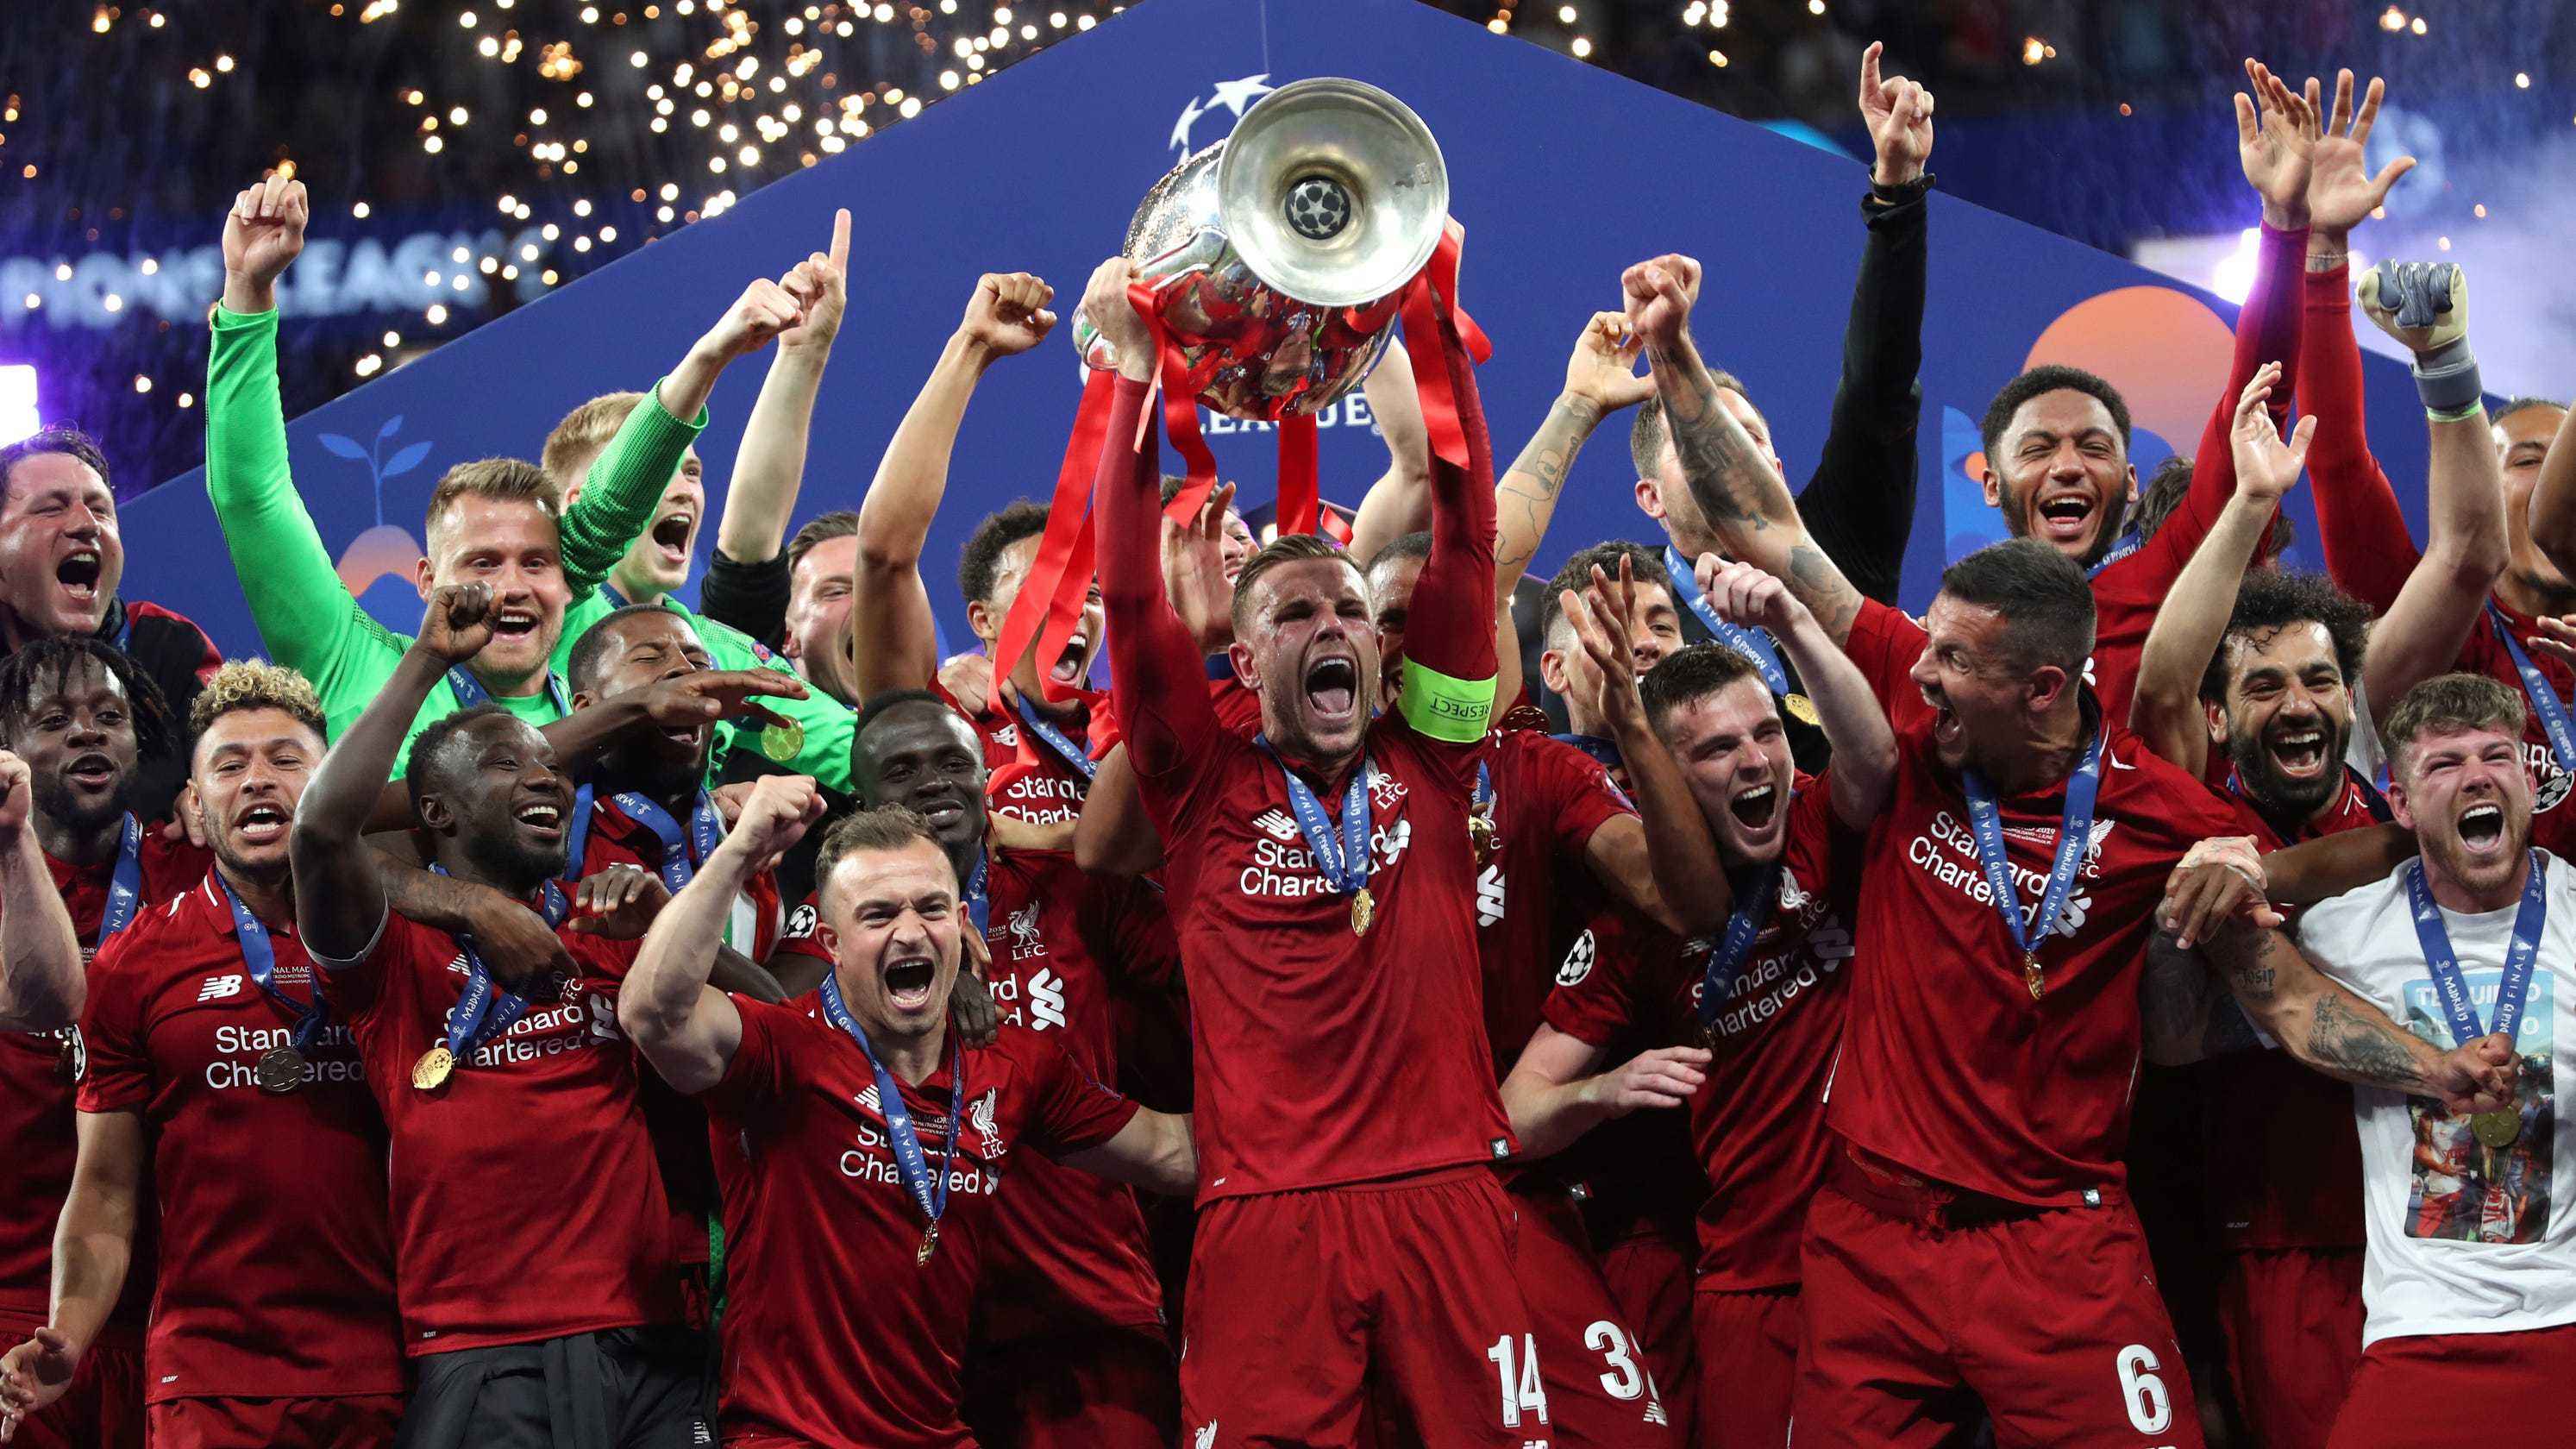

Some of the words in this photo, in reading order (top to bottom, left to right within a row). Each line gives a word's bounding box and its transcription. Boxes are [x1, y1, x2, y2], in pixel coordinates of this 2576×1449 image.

[1430, 697, 1490, 718] RESPECT
[1980, 812, 1996, 856] FINAL
[2041, 885, 2063, 930] FINAL
[2507, 954, 2526, 998] FINAL
[899, 1128, 921, 1175] FINAL
[1488, 1333, 1549, 1427] 14
[2115, 1343, 2172, 1435] 6
